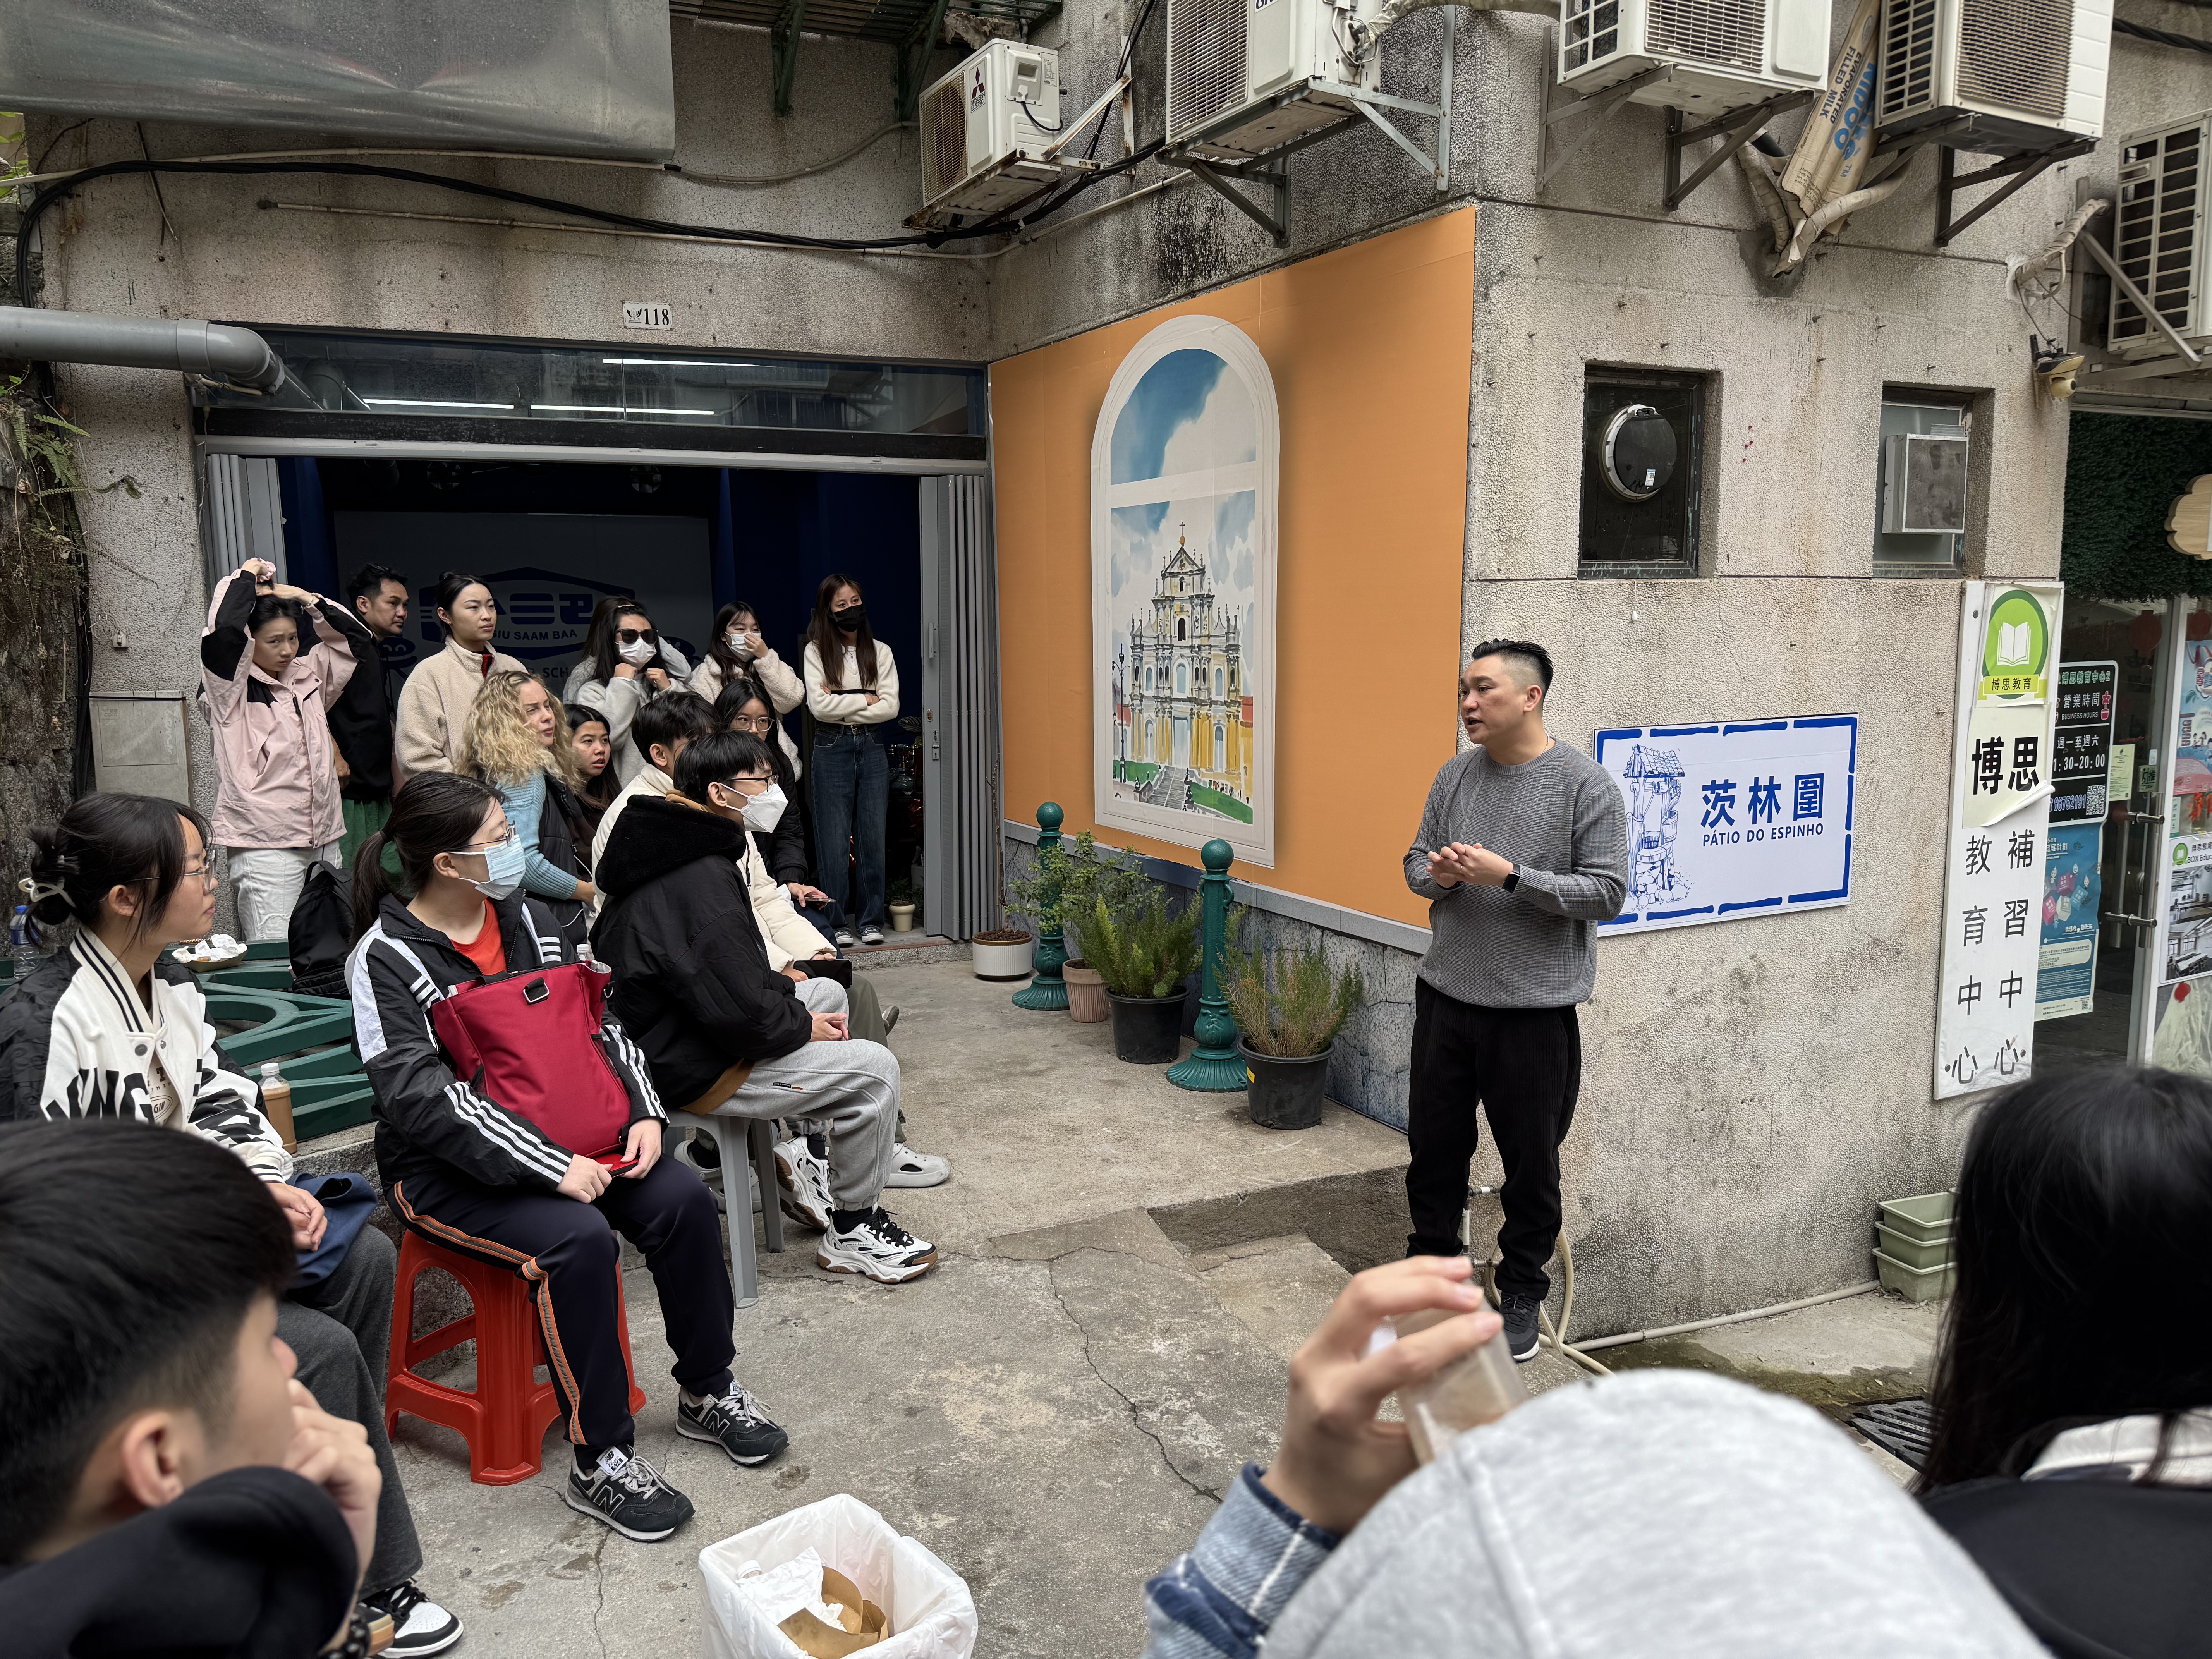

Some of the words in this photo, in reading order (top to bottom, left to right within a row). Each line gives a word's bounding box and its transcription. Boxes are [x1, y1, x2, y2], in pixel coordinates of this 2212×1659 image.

[1835, 46, 1856, 84] FILLED
[1830, 52, 1862, 124] EVAPORATED
[1819, 89, 1838, 118] MILK
[644, 308, 669, 325] 118
[514, 631, 549, 640] SAAM
[553, 629, 577, 639] BAA
[1991, 678, 2032, 691] 博思教育
[2063, 692, 2100, 709] 營業時間
[2057, 734, 2099, 749] 週一至週六
[1972, 735, 2040, 795] 博思
[1700, 773, 1824, 830] 茨林圍
[1704, 830, 1740, 847] PÁTIO
[1747, 830, 1765, 842] DO
[1771, 823, 1824, 840] ESPINHO
[1952, 834, 1993, 1084] 教育中心
[1994, 829, 2035, 1076] 補習中心
